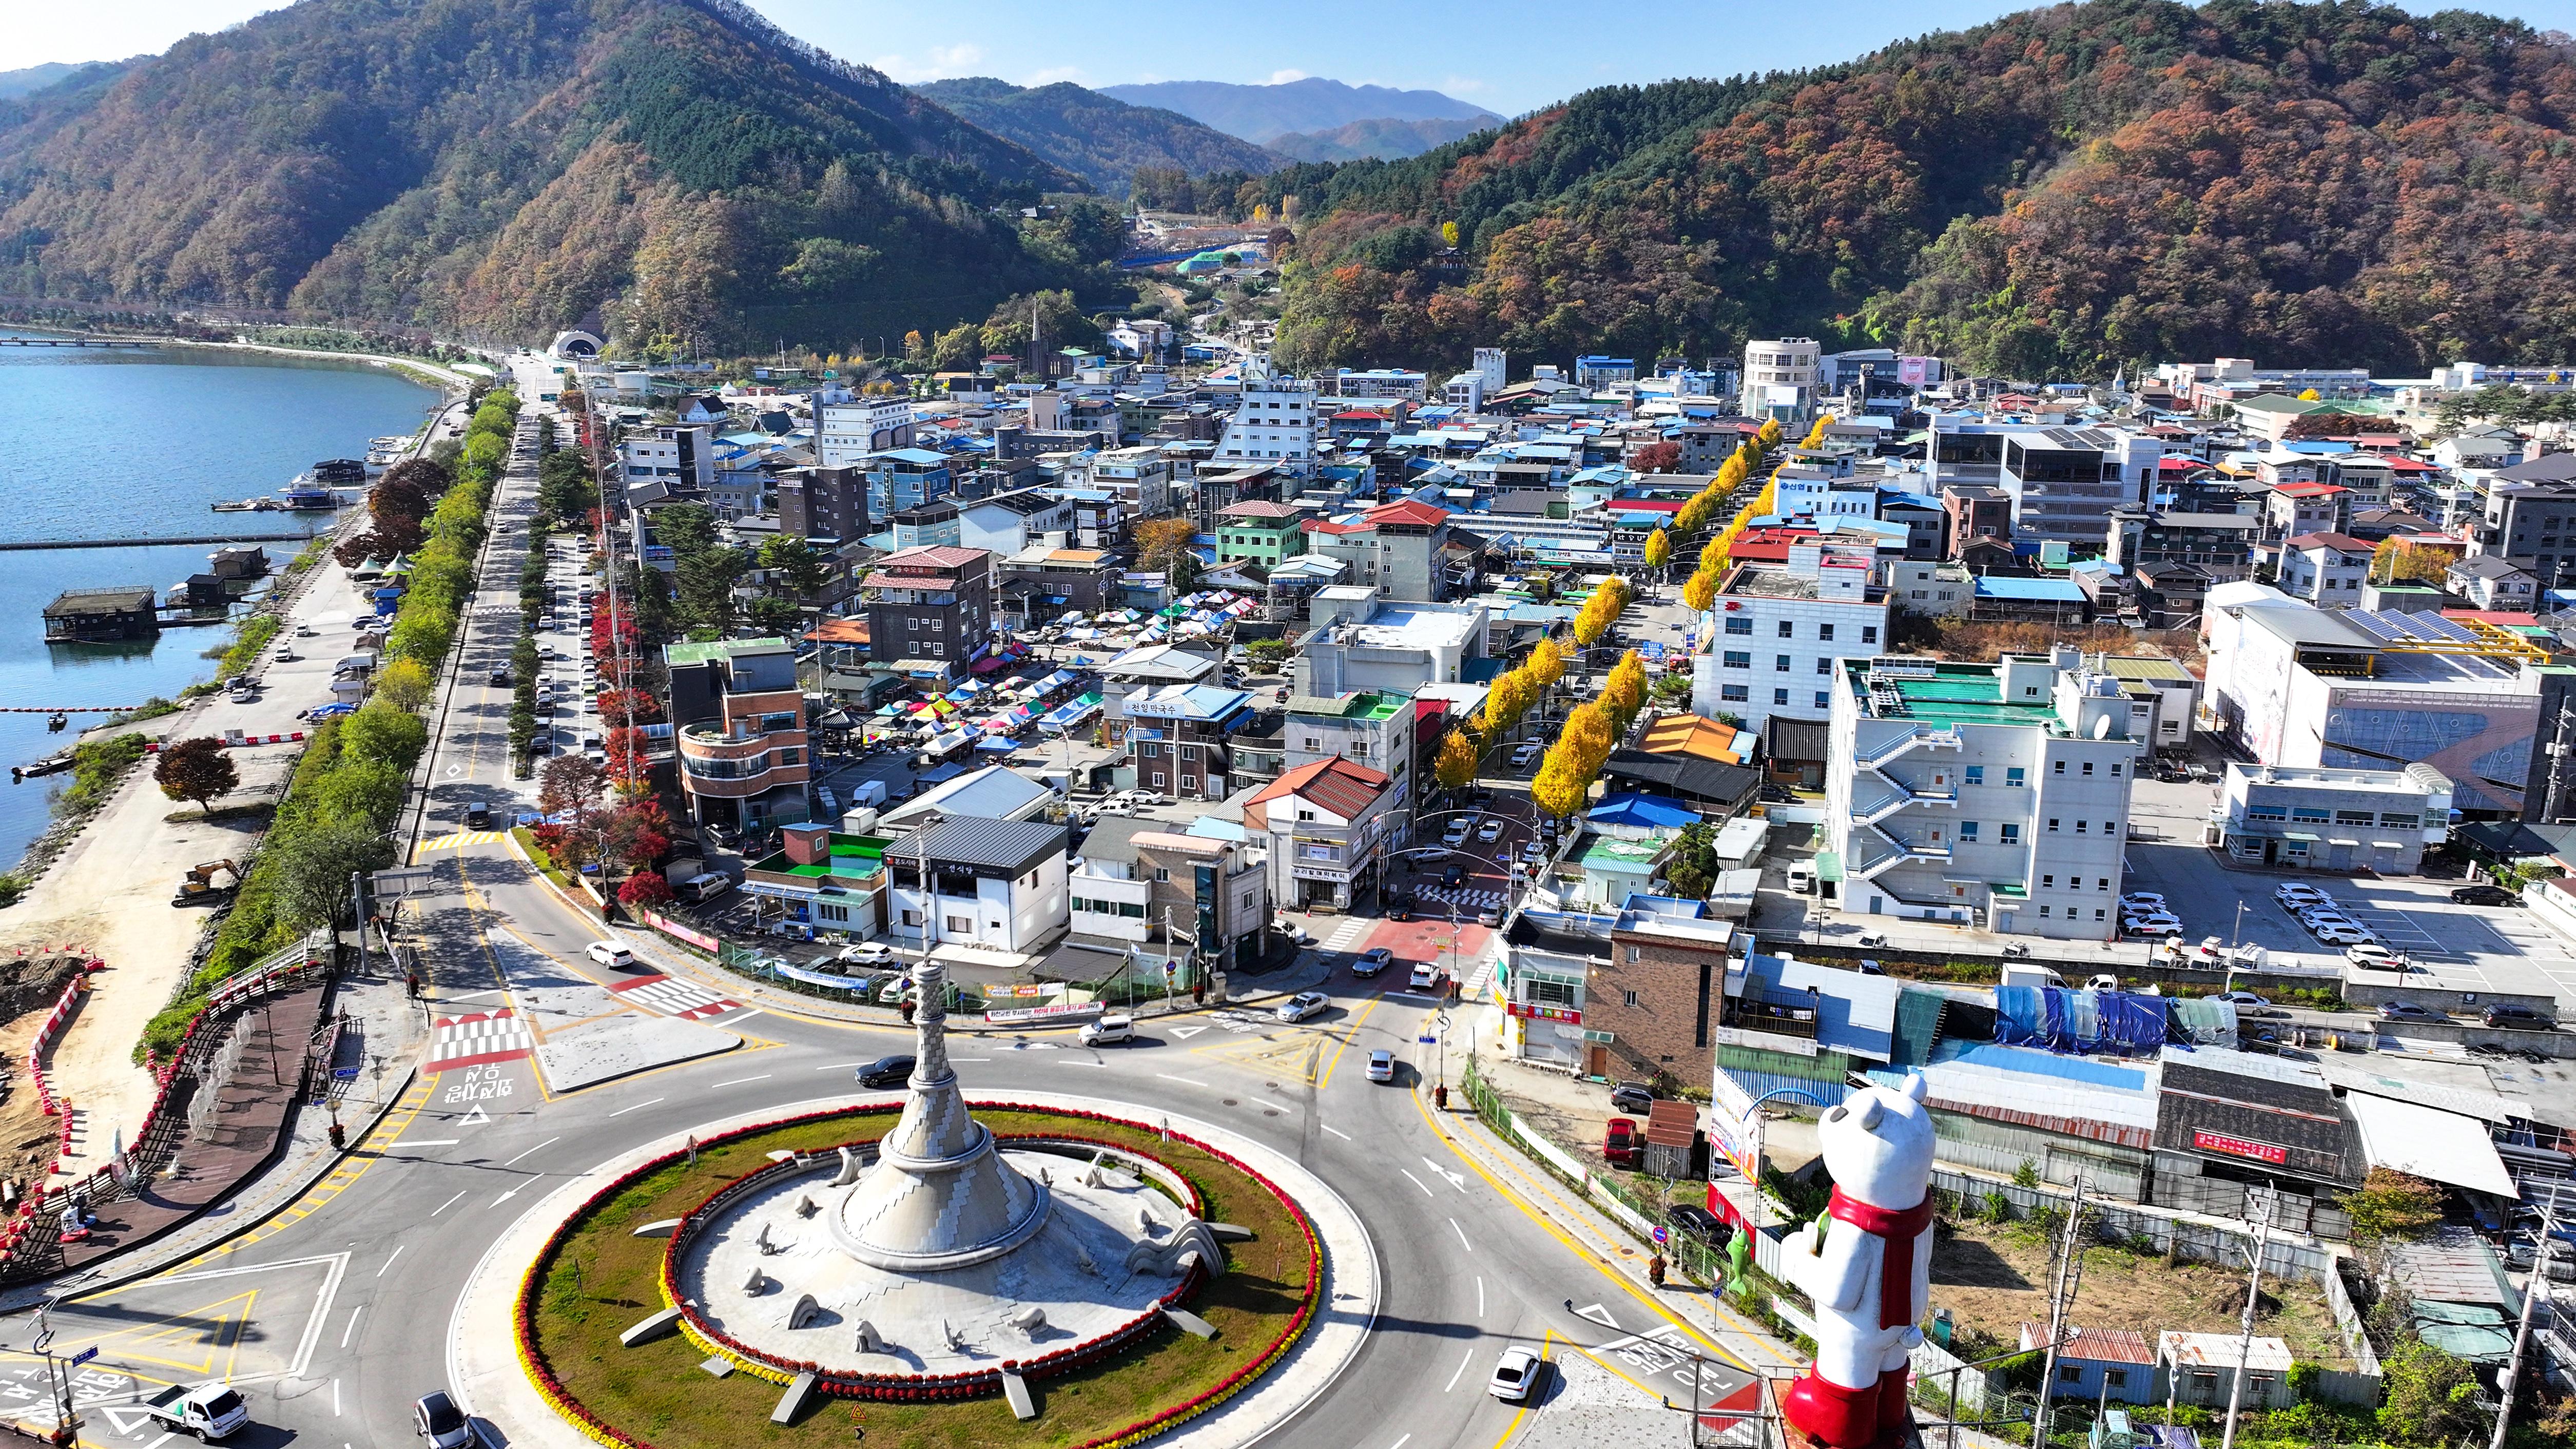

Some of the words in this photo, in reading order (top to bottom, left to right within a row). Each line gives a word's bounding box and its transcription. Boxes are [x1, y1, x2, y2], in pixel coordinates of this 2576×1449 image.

[2335, 691, 2347, 705] P
[1132, 703, 1176, 715] 천일막국수
[1294, 868, 1345, 879] 우리할매떡볶이
[464, 1062, 501, 1083] 우선
[444, 1078, 514, 1104] 회전차량
